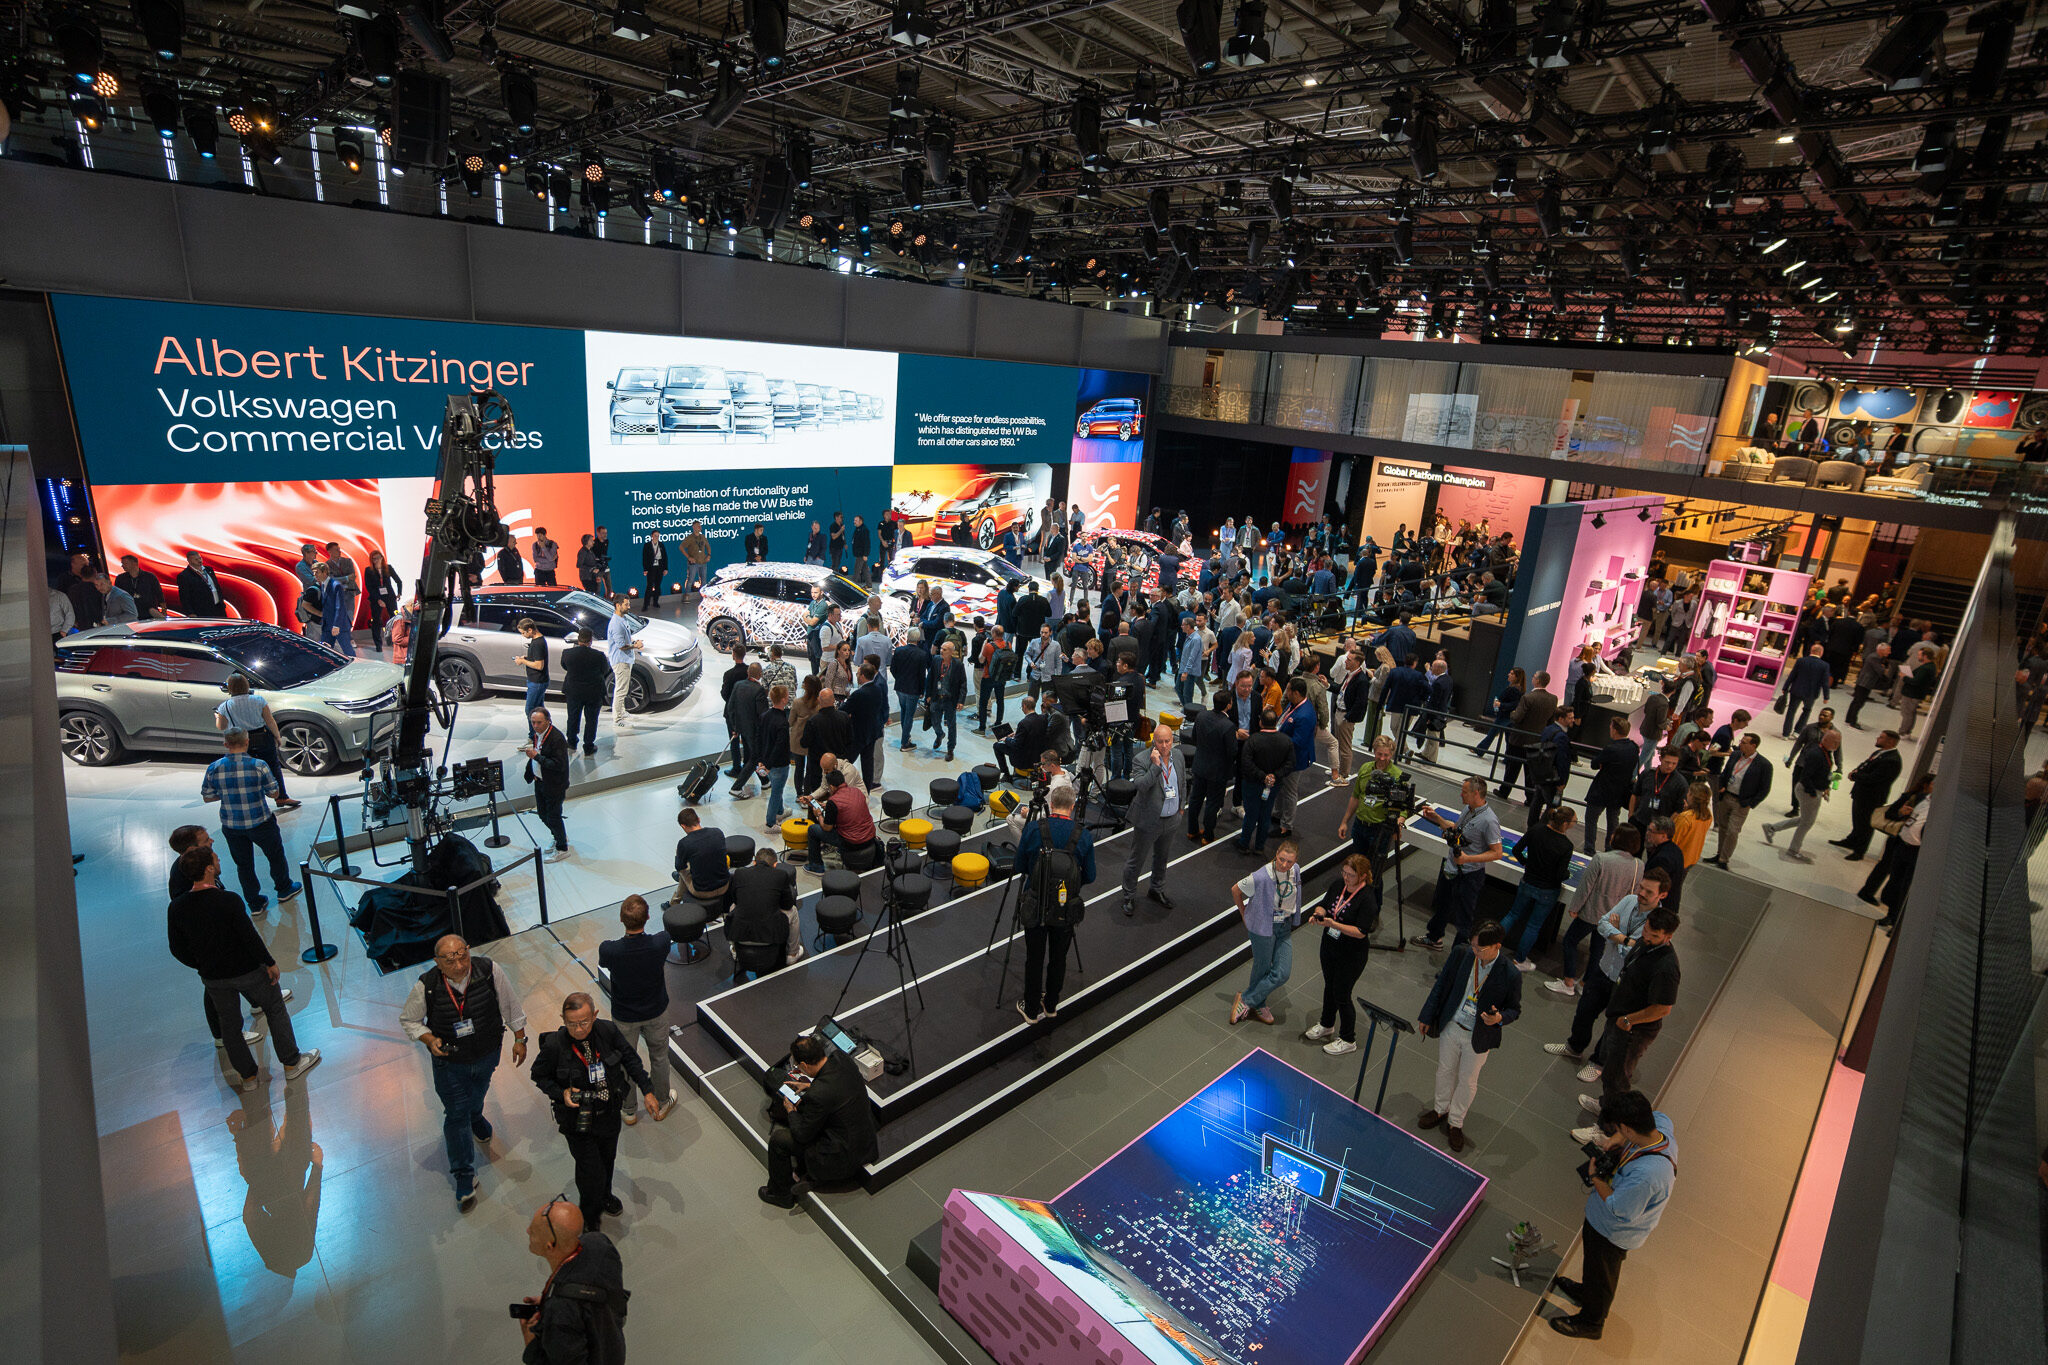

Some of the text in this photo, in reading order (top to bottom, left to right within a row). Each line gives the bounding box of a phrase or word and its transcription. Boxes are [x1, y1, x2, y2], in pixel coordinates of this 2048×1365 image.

[154, 336, 534, 392] Albert Kitzinger
[157, 388, 397, 426] Volkswagen
[934, 414, 951, 423] offer
[952, 416, 972, 424] space
[974, 415, 983, 424] for
[984, 416, 1009, 424] endless
[1010, 417, 1046, 426] possibilities,
[167, 424, 543, 452] Commercial Vcles
[918, 426, 940, 435] which
[942, 426, 954, 435] has
[956, 426, 999, 436] distinguished
[1000, 427, 1011, 435] the
[1012, 427, 1025, 435] VW
[918, 437, 935, 446] from
[937, 438, 945, 446] all
[946, 438, 965, 446] other
[981, 438, 998, 446] since
[1383, 466, 1485, 488] Global Platform Champion
[654, 488, 718, 500] combination
[720, 487, 732, 497] of
[733, 485, 790, 497] functionality
[791, 485, 808, 494] and
[632, 497, 814, 516] iconic style has made the VW Bus the
[632, 520, 660, 530] most
[718, 512, 773, 525] commercial
[775, 510, 806, 521] vehicle
[633, 534, 642, 544] in
